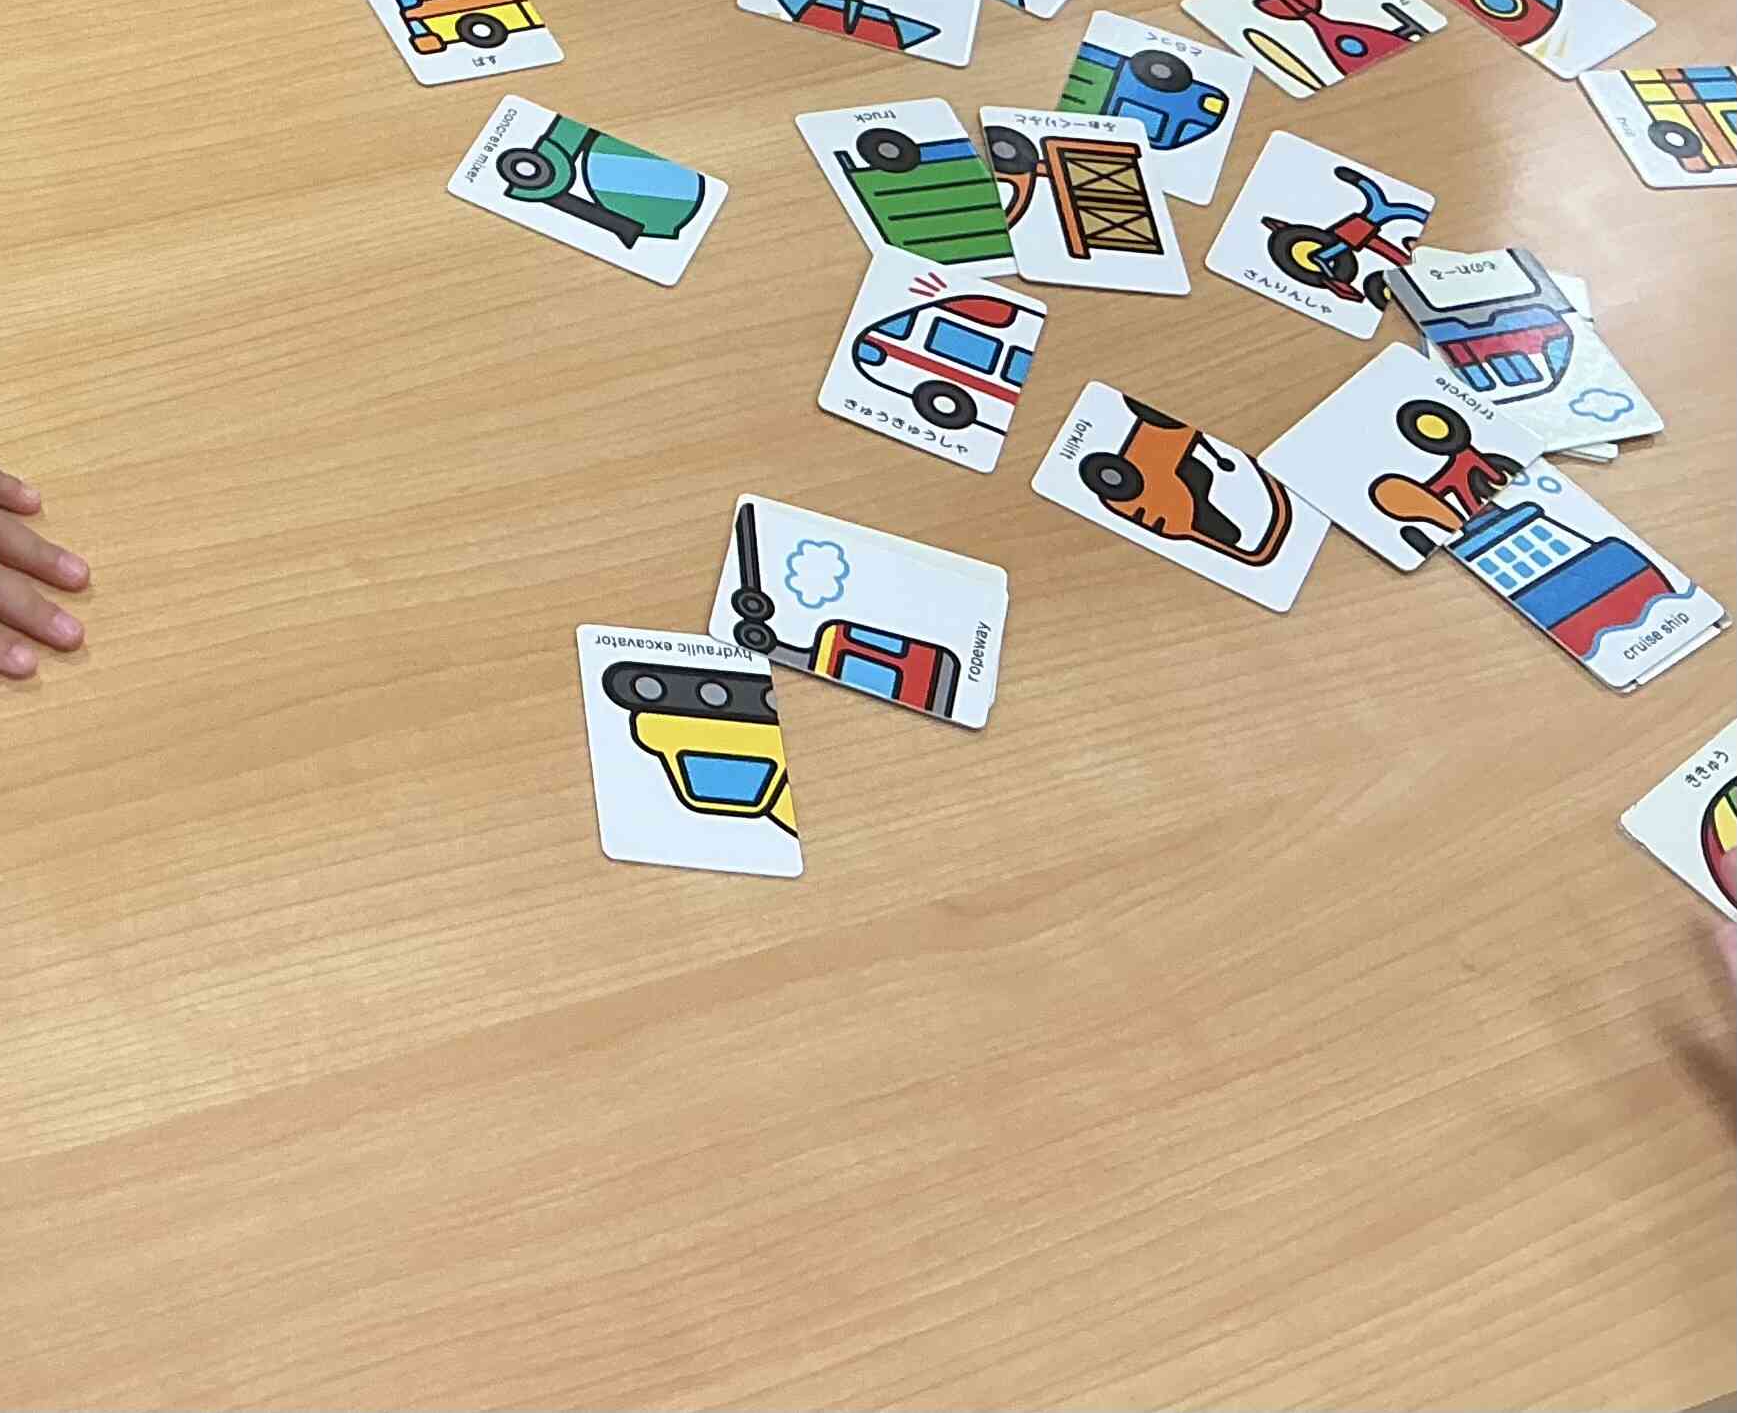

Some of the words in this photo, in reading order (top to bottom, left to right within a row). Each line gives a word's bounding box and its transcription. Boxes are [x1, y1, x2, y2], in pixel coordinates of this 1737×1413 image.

[483, 108, 518, 152] concrete
[854, 108, 897, 123] truck
[465, 153, 489, 183] mixer
[1243, 268, 1333, 315] さんりんしゃ
[1429, 260, 1496, 281] ものれーる
[1435, 377, 1494, 421] tricycle
[843, 398, 969, 455] きゅうきゅうしゃ
[1059, 418, 1093, 461] forklift
[595, 634, 673, 651] excavator
[678, 642, 753, 662] hydraulic
[968, 620, 992, 684] ropeway
[1624, 631, 1664, 660] cruise
[1660, 612, 1690, 634] ship
[1685, 750, 1730, 788] ききゅう
